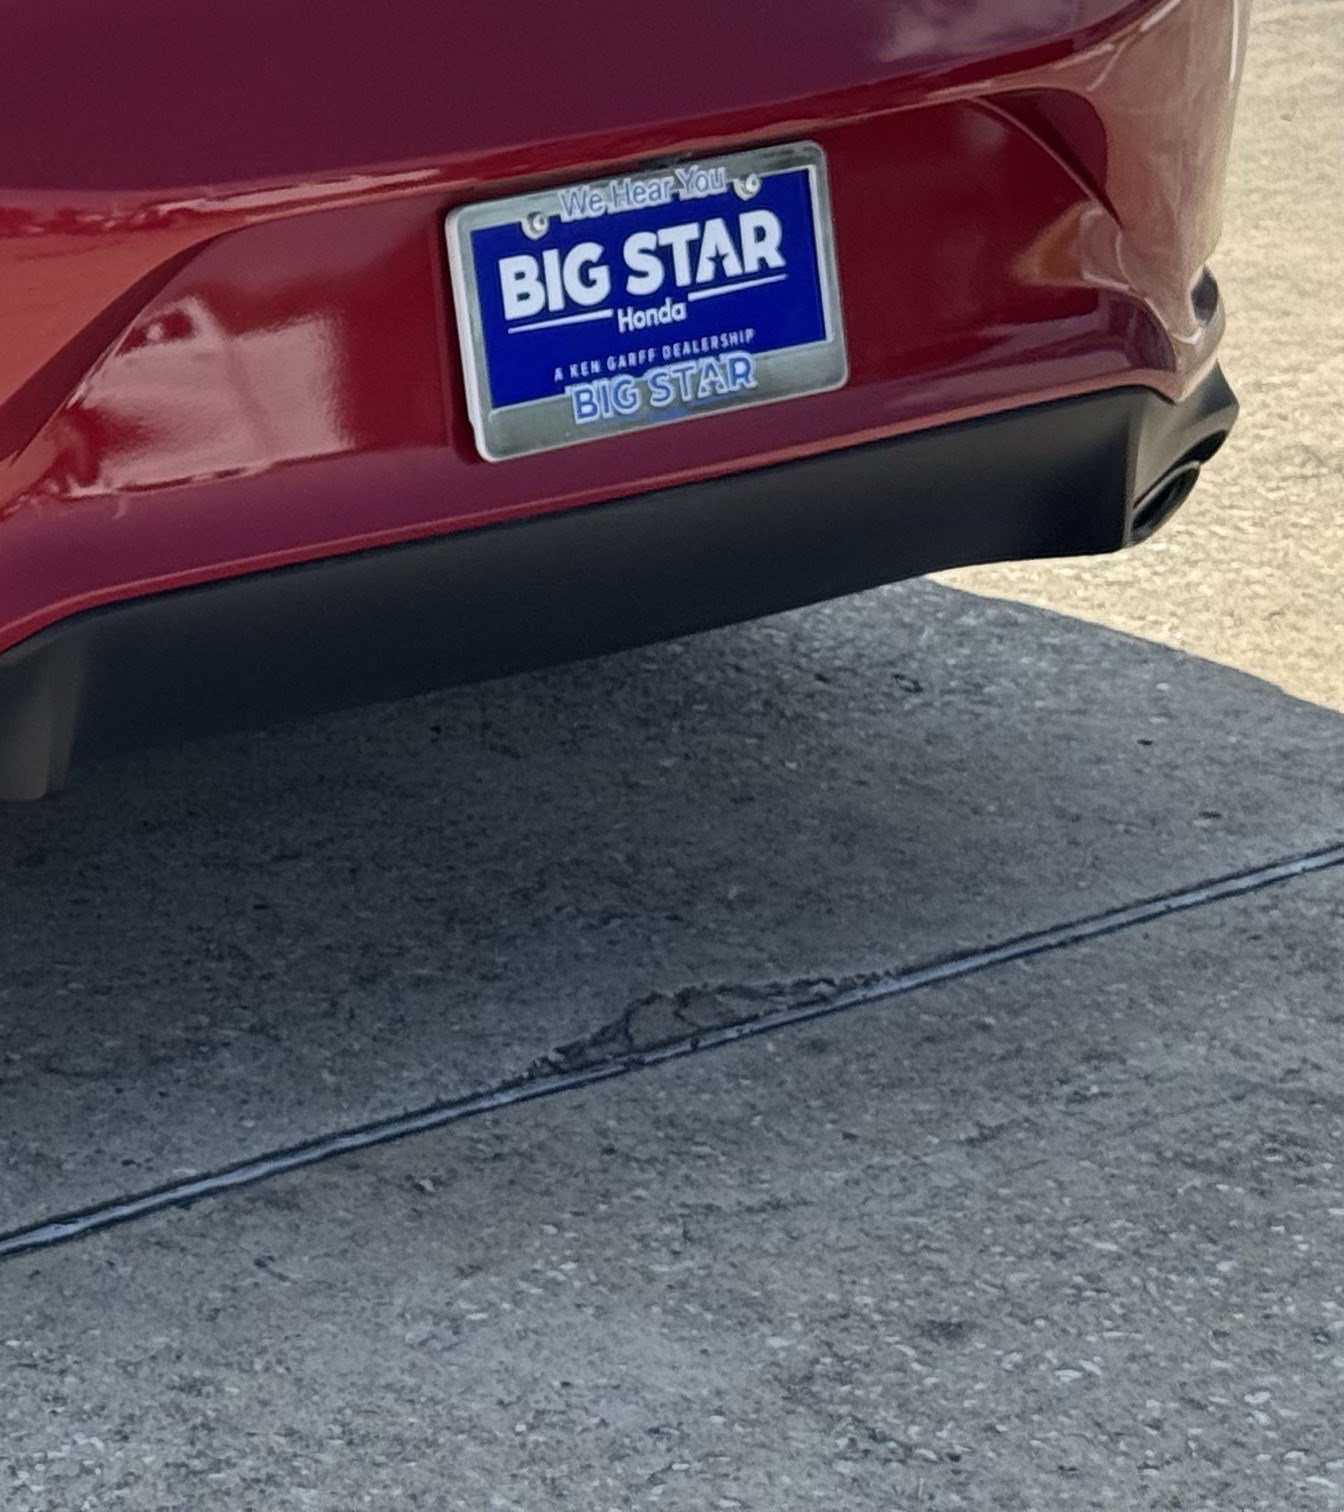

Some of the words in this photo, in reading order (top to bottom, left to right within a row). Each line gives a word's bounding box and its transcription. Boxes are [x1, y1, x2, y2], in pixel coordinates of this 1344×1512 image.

[560, 187, 606, 219] We
[610, 177, 675, 210] Hear
[675, 166, 727, 196] You
[498, 242, 612, 321] BIG
[622, 209, 787, 296] STAR
[616, 297, 687, 333] Honda
[553, 367, 564, 383] A
[569, 359, 602, 379] KEN
[606, 347, 657, 371] GARFF
[662, 328, 756, 360] DEALERSHIP
[572, 374, 641, 424] BIG
[647, 351, 759, 407] STAR
